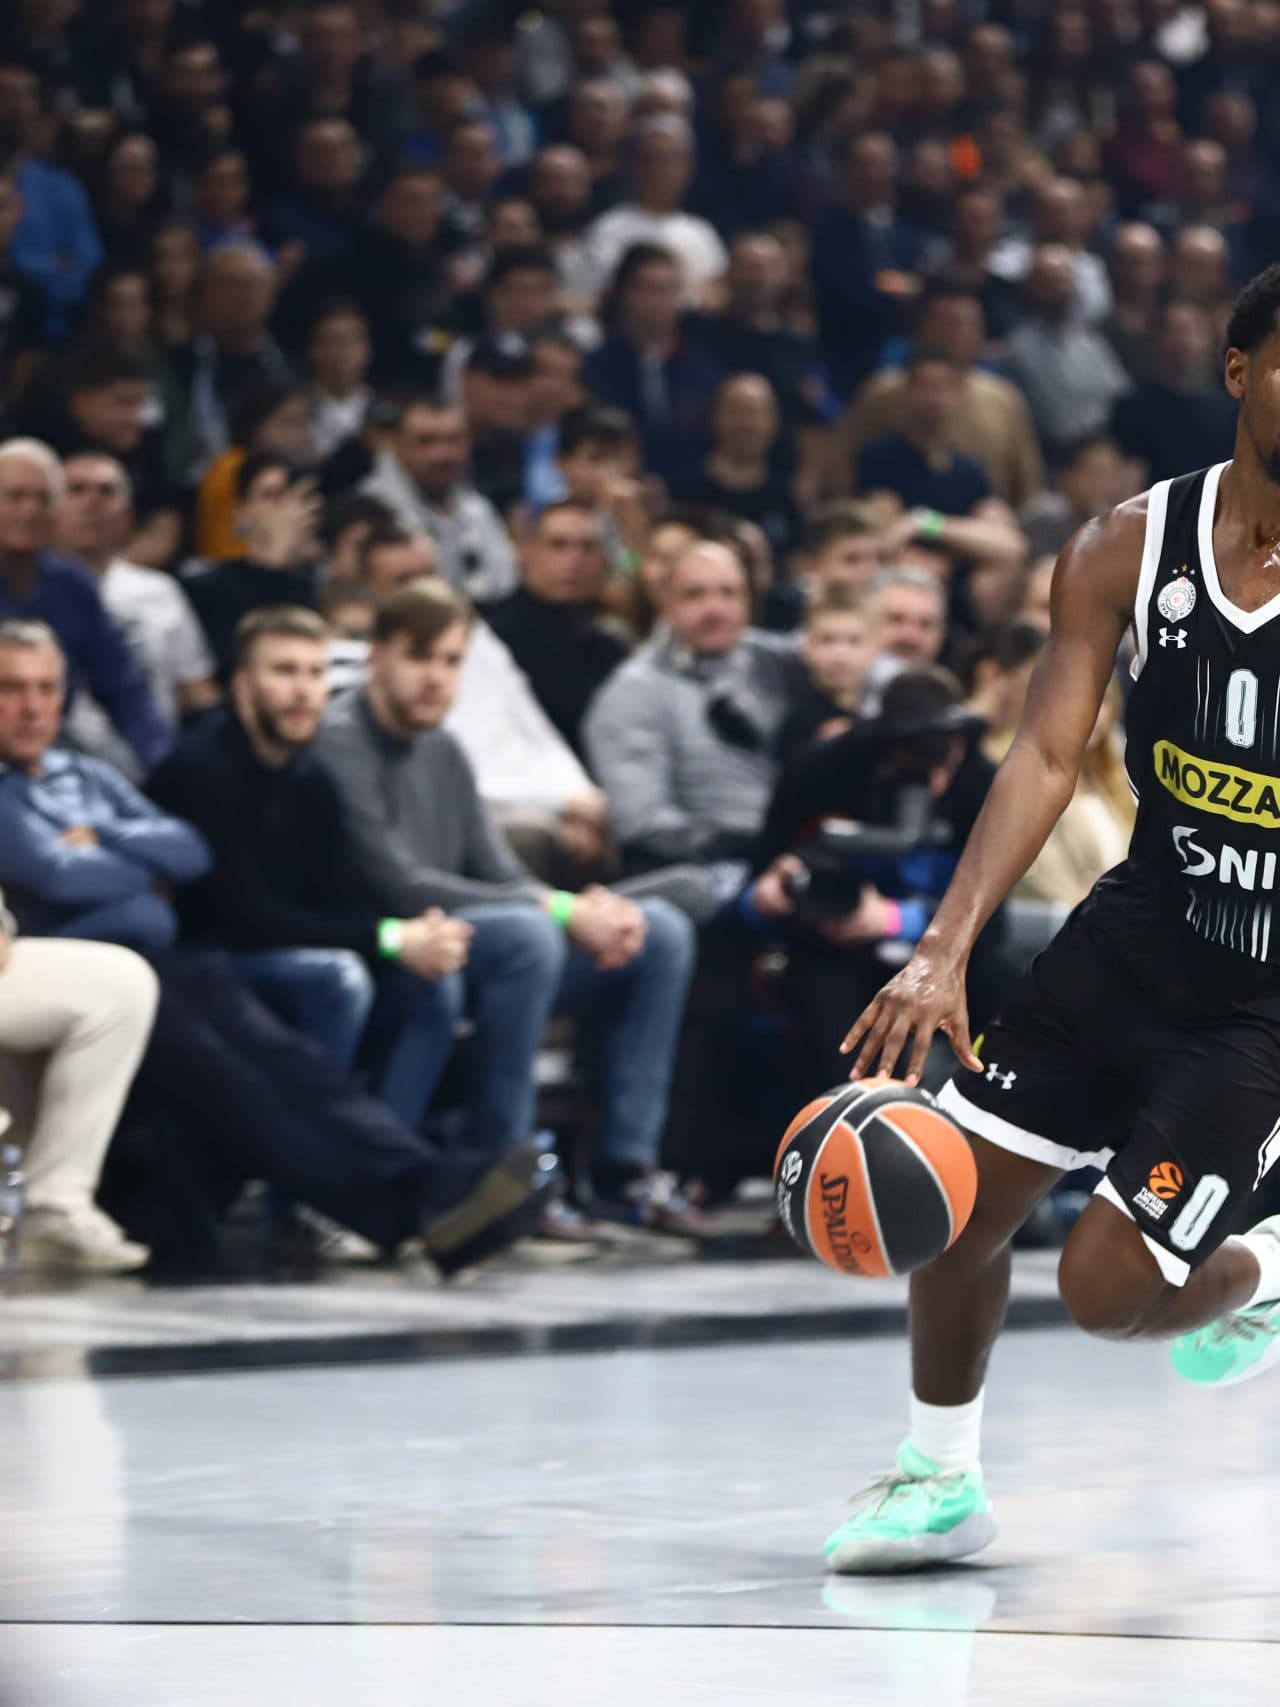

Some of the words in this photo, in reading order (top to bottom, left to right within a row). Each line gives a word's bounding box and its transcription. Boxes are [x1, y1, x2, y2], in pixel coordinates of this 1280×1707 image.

[1226, 668, 1258, 749] 0
[820, 1173, 866, 1275] SPALD
[1169, 1173, 1230, 1251] 0
